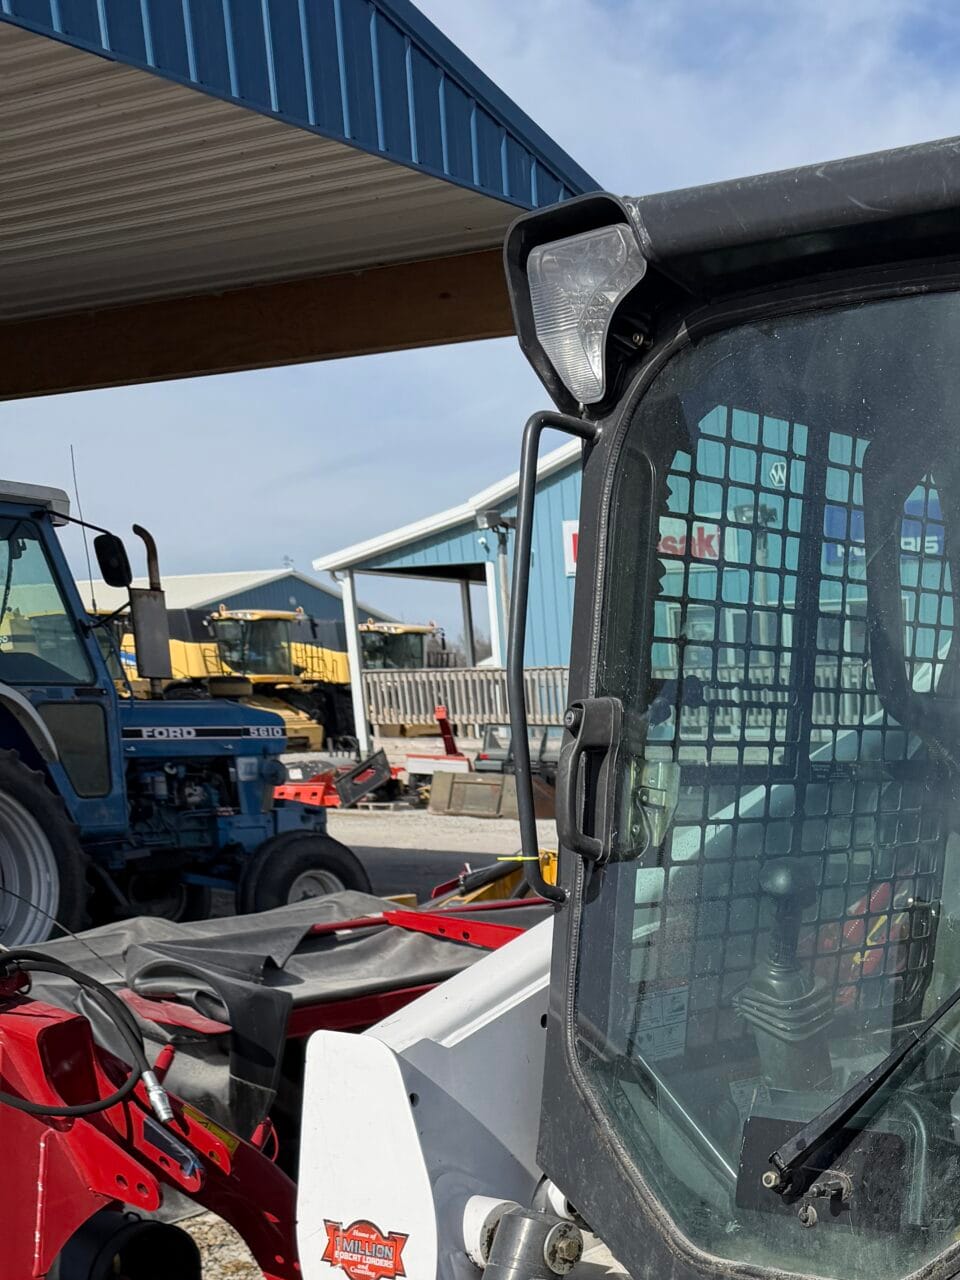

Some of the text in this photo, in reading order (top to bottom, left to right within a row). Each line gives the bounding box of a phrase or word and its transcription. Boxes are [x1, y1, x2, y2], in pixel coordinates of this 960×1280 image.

[142, 728, 196, 738] FORD
[250, 728, 282, 736] 5610
[343, 1238, 394, 1260] MILLION
[334, 1250, 394, 1269] BOBCAT LOADERS
